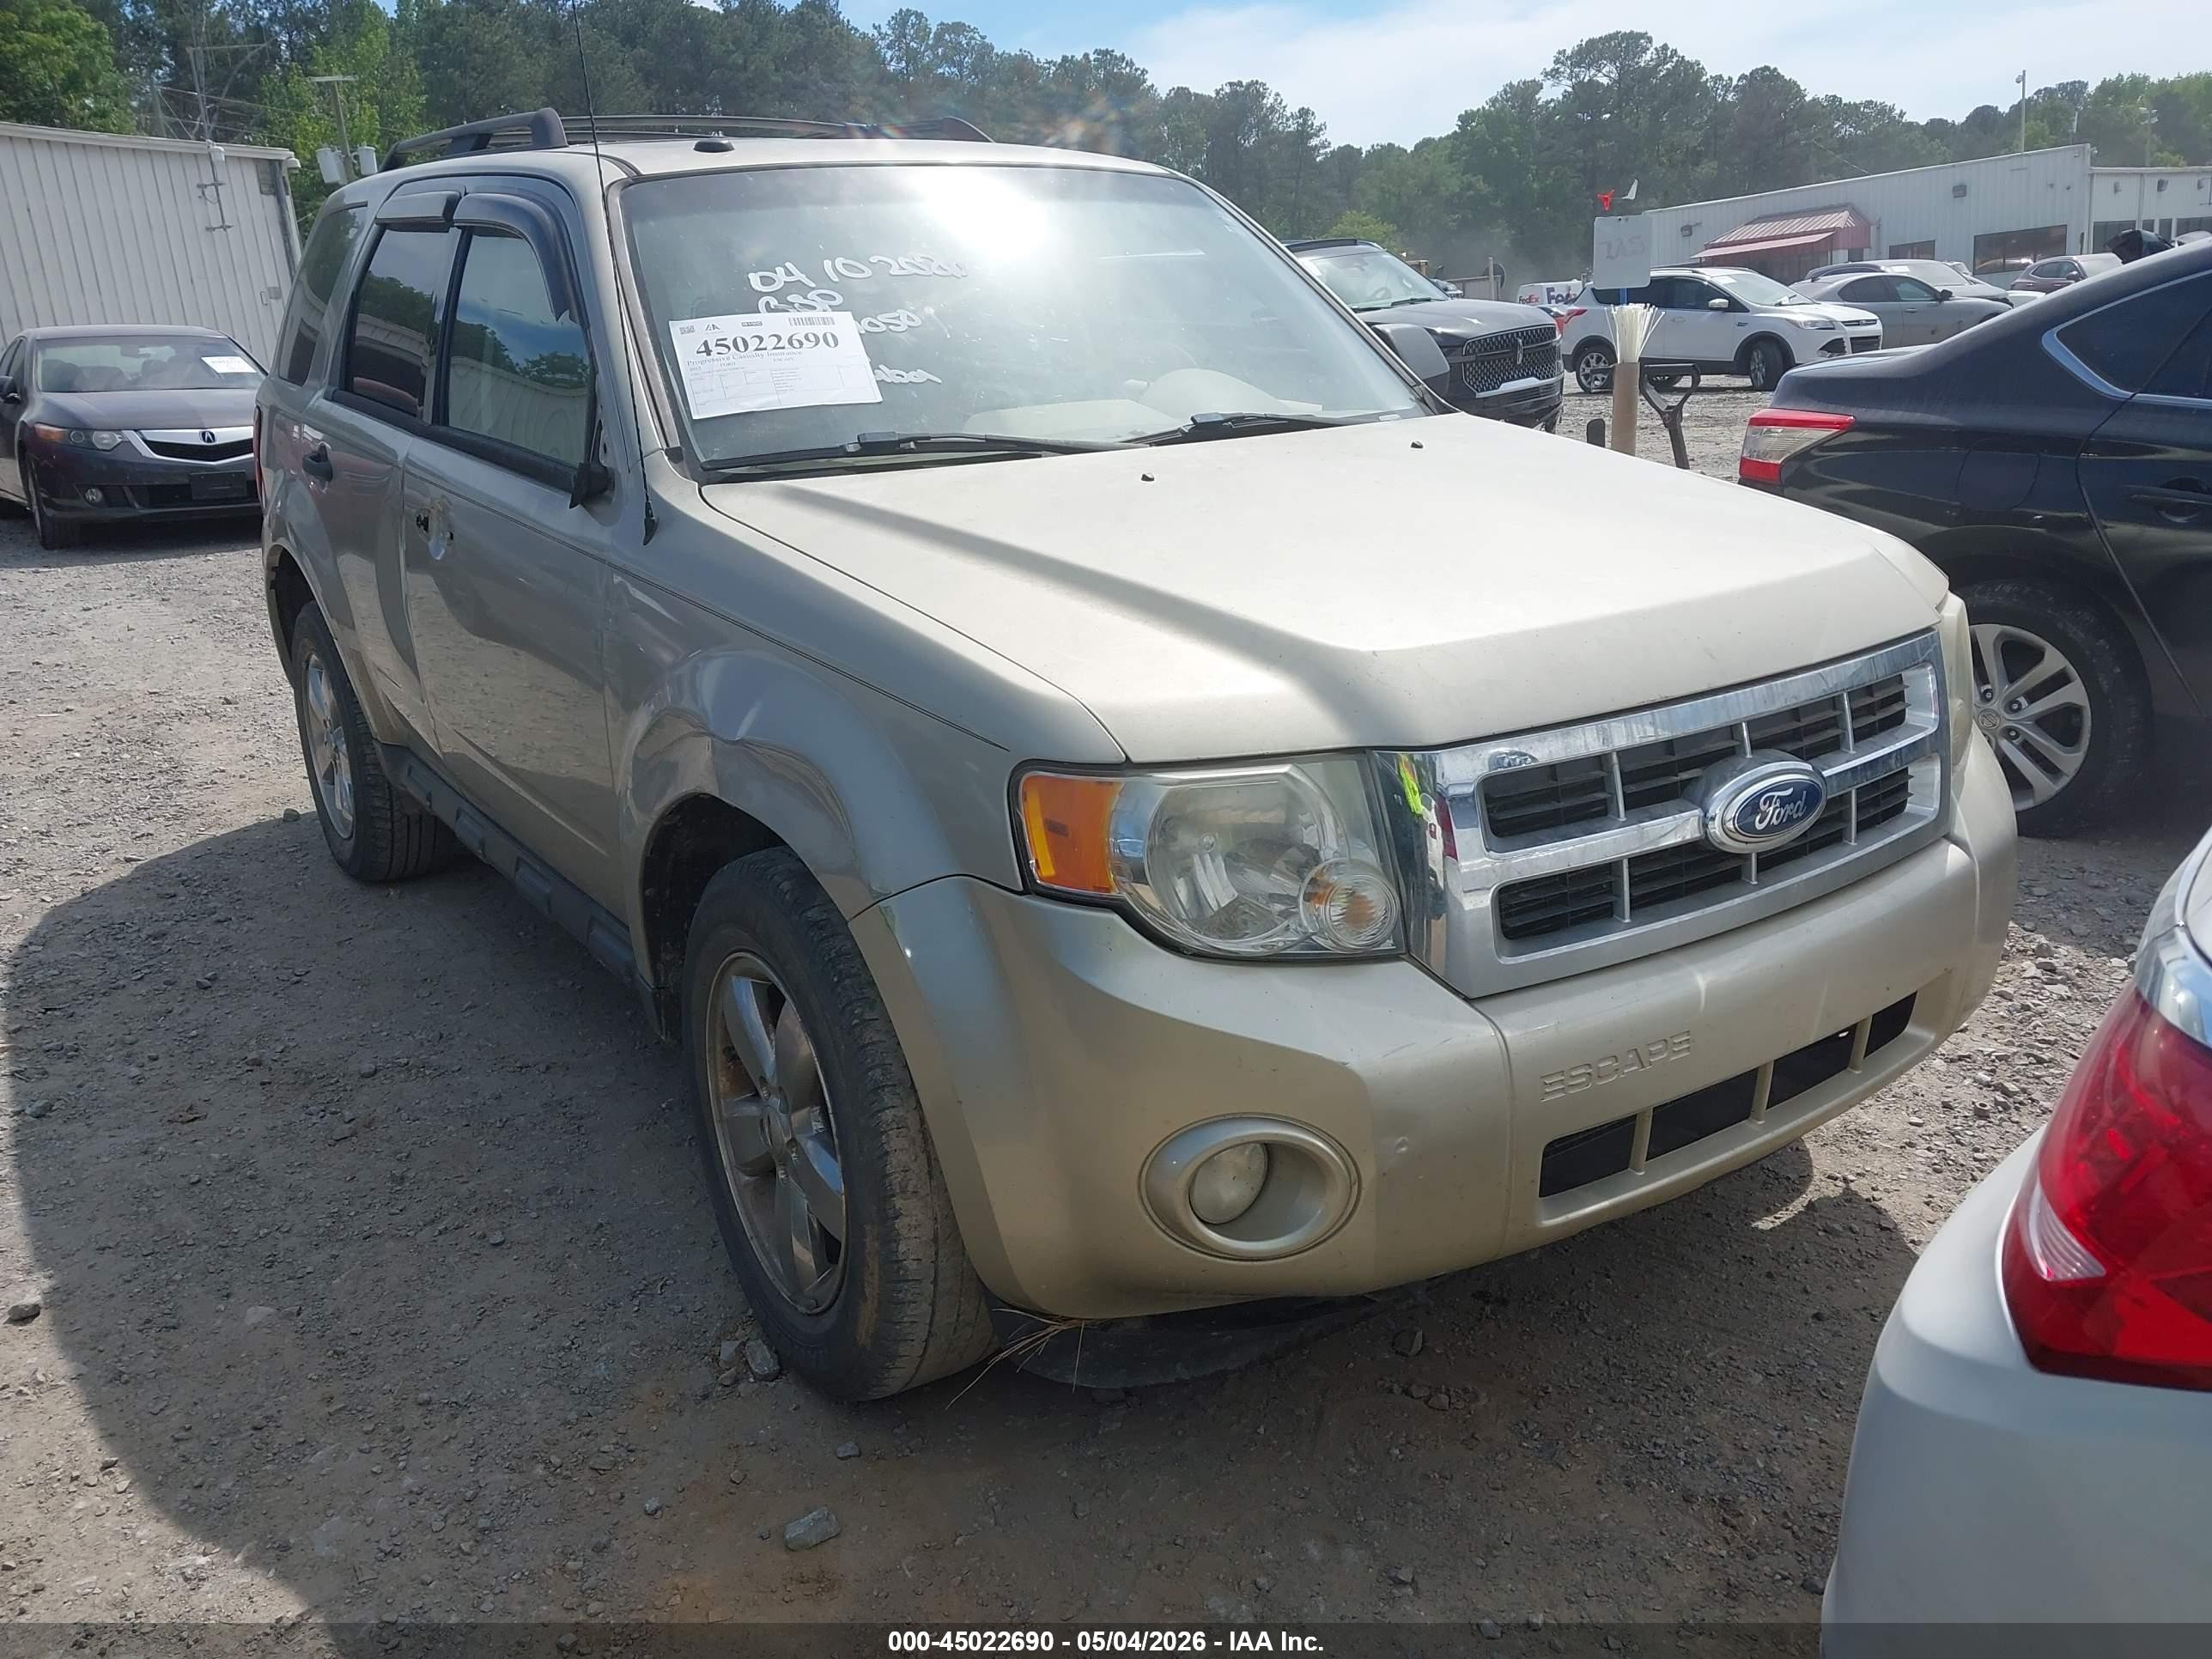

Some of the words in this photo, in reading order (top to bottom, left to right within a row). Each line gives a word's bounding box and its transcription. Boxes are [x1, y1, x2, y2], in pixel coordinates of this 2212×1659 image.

[687, 356, 730, 367] Progressive
[732, 352, 765, 361] Casualty
[696, 331, 839, 357] 45022690
[1754, 787, 1808, 830] Ford
[1540, 1030, 1691, 1103] ESCAPE
